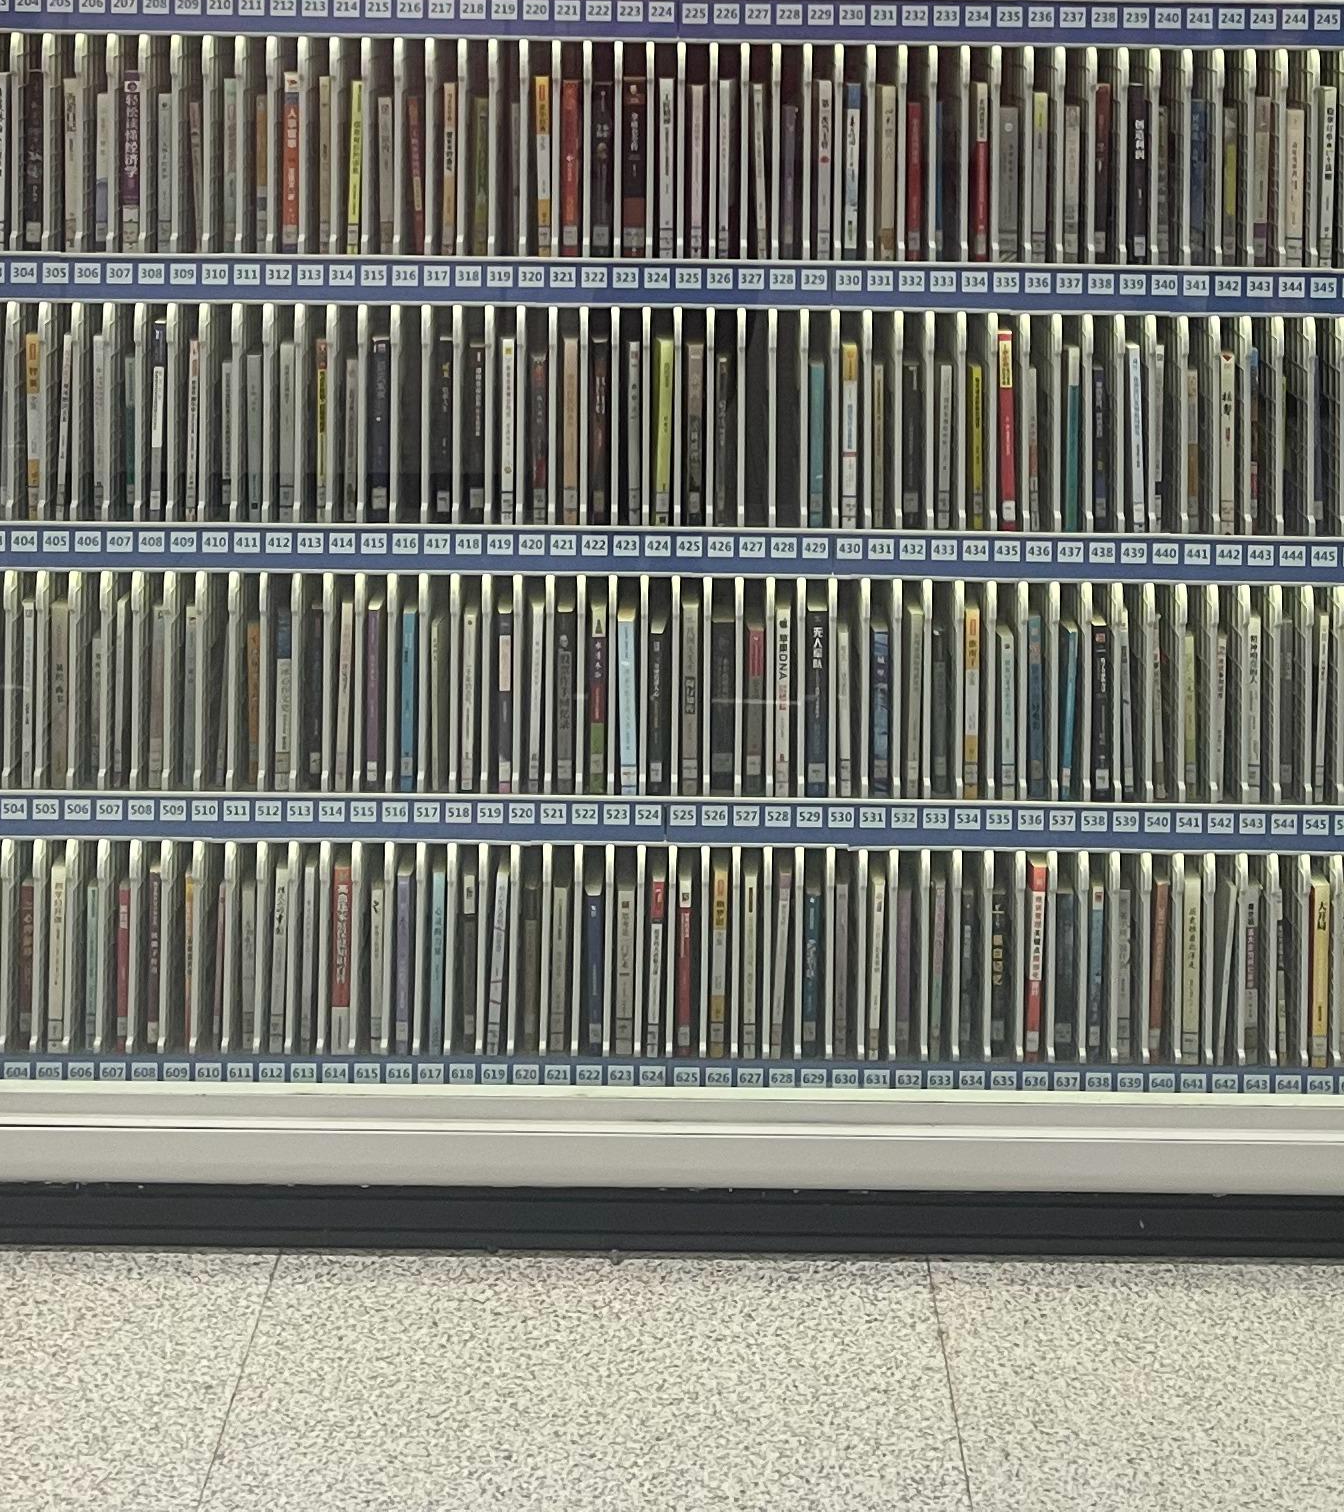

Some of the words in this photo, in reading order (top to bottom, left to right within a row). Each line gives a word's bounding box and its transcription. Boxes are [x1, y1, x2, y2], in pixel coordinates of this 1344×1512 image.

[241, 0, 261, 10] 211
[400, 2, 421, 13] 216
[557, 5, 577, 16] 221
[716, 8, 737, 19] 226
[874, 10, 893, 20] 231
[1031, 11, 1052, 22] 236
[1190, 13, 1210, 23] 241
[77, 268, 98, 278] 306
[237, 269, 257, 279] 311
[395, 270, 416, 281] 316
[552, 272, 573, 282] 321
[710, 273, 730, 284] 326
[870, 275, 890, 286] 331
[1028, 277, 1048, 288] 336
[1186, 280, 1206, 290] 341
[77, 536, 99, 546] 406
[236, 537, 257, 547] 411
[395, 538, 416, 548] 416
[553, 539, 573, 550] 421
[710, 541, 731, 551] 426
[870, 544, 891, 554] 431
[1028, 546, 1049, 556] 436
[1187, 549, 1208, 559] 441
[67, 804, 88, 814] 506
[226, 806, 247, 816] 511
[385, 807, 406, 817] 516
[543, 808, 563, 818] 521
[704, 810, 725, 821] 526
[862, 812, 883, 822] 531
[1021, 815, 1042, 825] 536
[1179, 817, 1199, 827] 541
[69, 1067, 91, 1078] 606
[228, 1067, 250, 1078] 611
[388, 1068, 410, 1079] 616
[547, 1070, 568, 1080] 621
[707, 1072, 729, 1083] 626
[865, 1074, 887, 1085] 631
[1024, 1076, 1046, 1087] 636
[1183, 1079, 1204, 1090] 641
